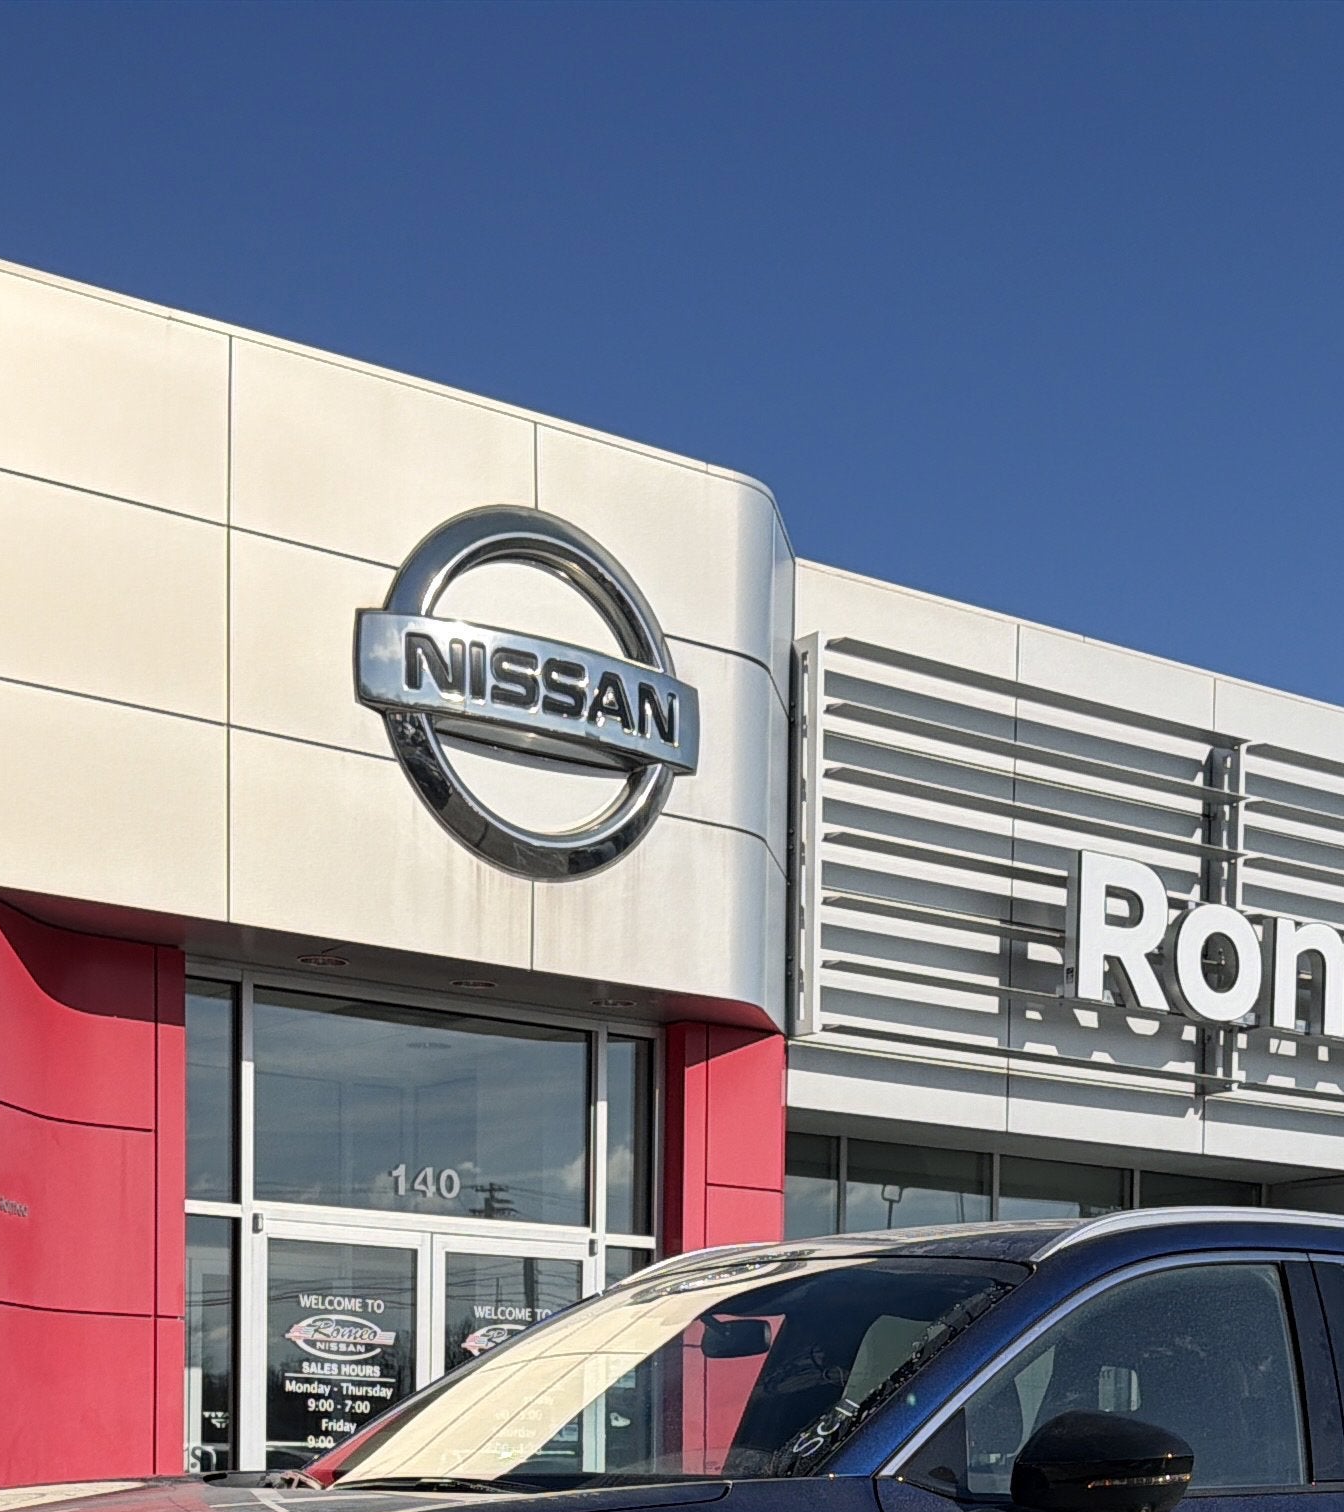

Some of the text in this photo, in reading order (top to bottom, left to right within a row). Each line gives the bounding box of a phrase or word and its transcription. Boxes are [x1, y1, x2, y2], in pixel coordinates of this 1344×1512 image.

[403, 631, 679, 748] NISSAN
[391, 1163, 461, 1199] 140
[299, 1294, 385, 1314] WELCOME TO
[474, 1305, 532, 1321] WELCOME
[311, 1317, 378, 1341] Romeo
[316, 1342, 366, 1353] NISSAN
[302, 1361, 381, 1377] SALES HOURS
[285, 1379, 331, 1396] Monday
[342, 1383, 394, 1400] Thursday
[307, 1398, 335, 1412] 9:00
[344, 1400, 371, 1413] 7:00
[321, 1418, 357, 1432] Friday
[307, 1435, 334, 1449] 9:00
